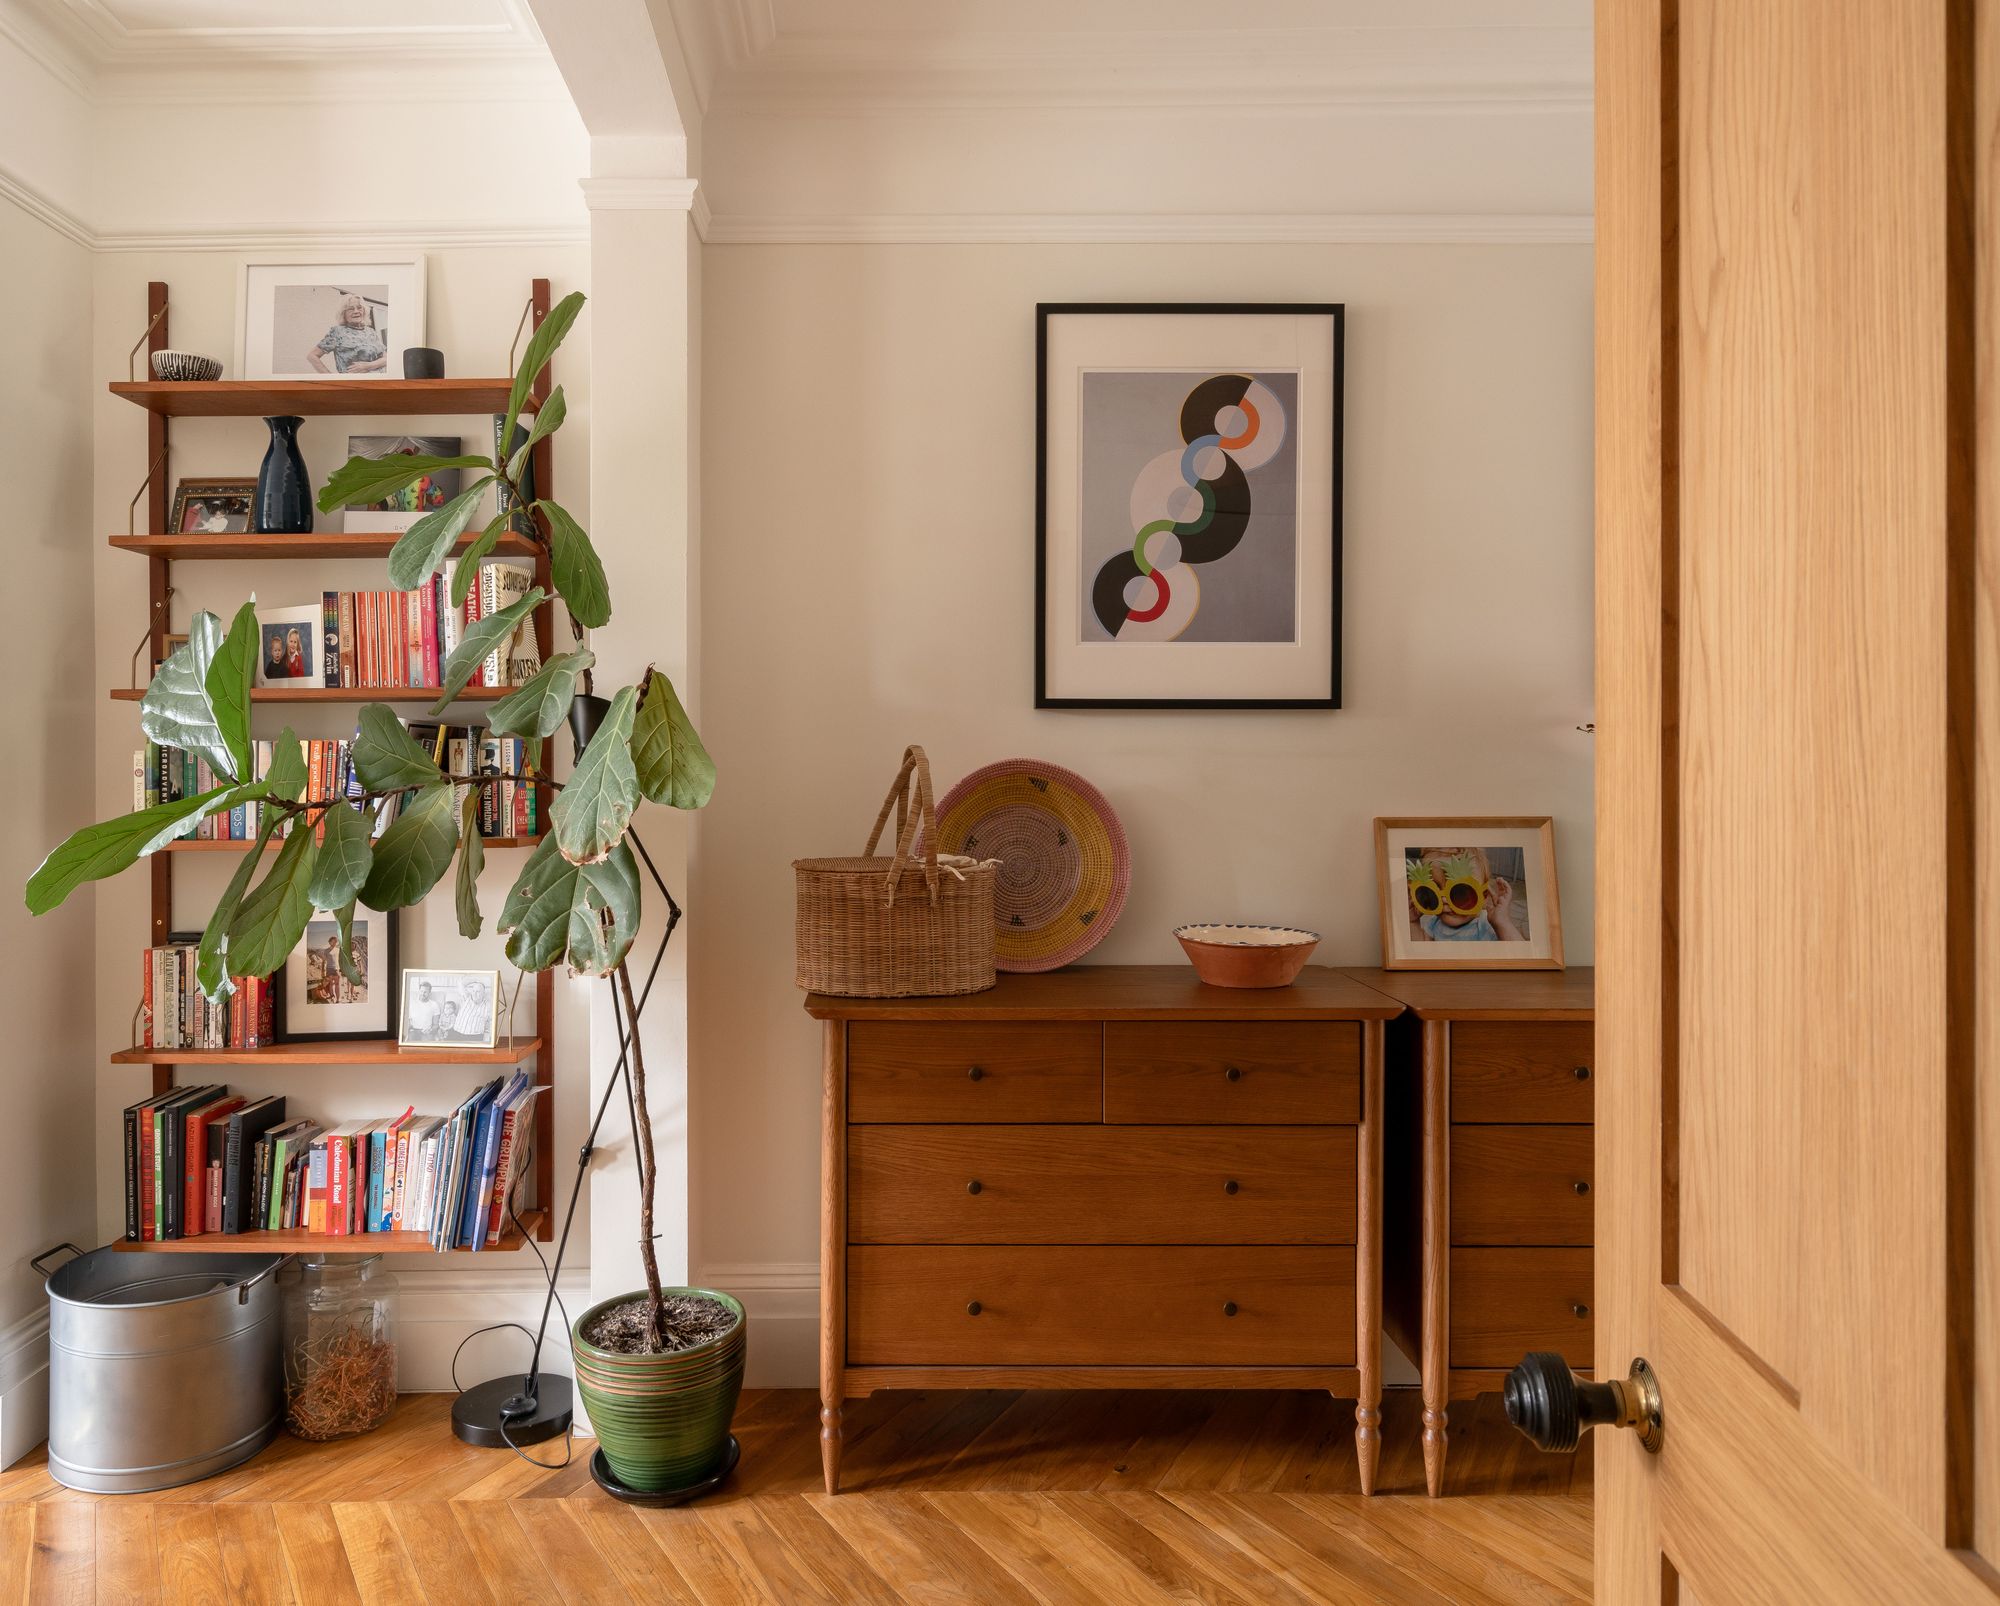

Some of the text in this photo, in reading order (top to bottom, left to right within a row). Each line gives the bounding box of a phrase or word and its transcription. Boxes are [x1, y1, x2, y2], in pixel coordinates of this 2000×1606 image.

[326, 652, 334, 675] Zevin
[484, 769, 492, 833] JONATHAN FRAEN
[233, 806, 243, 827] HOS
[166, 952, 174, 967] MAYA
[166, 968, 174, 992] ANGELOU
[194, 993, 202, 1038] IRVINE WELSH
[228, 1126, 241, 1166] YELLOWFACE
[476, 1127, 486, 1156] Complete
[494, 1114, 516, 1191] THE GRUMPUS
[334, 1140, 343, 1183] Caledonian
[397, 1142, 406, 1178] HOMEGOING
[473, 1156, 482, 1176] Pilates
[333, 1184, 342, 1204] Road
[471, 1176, 480, 1192] Tutor
